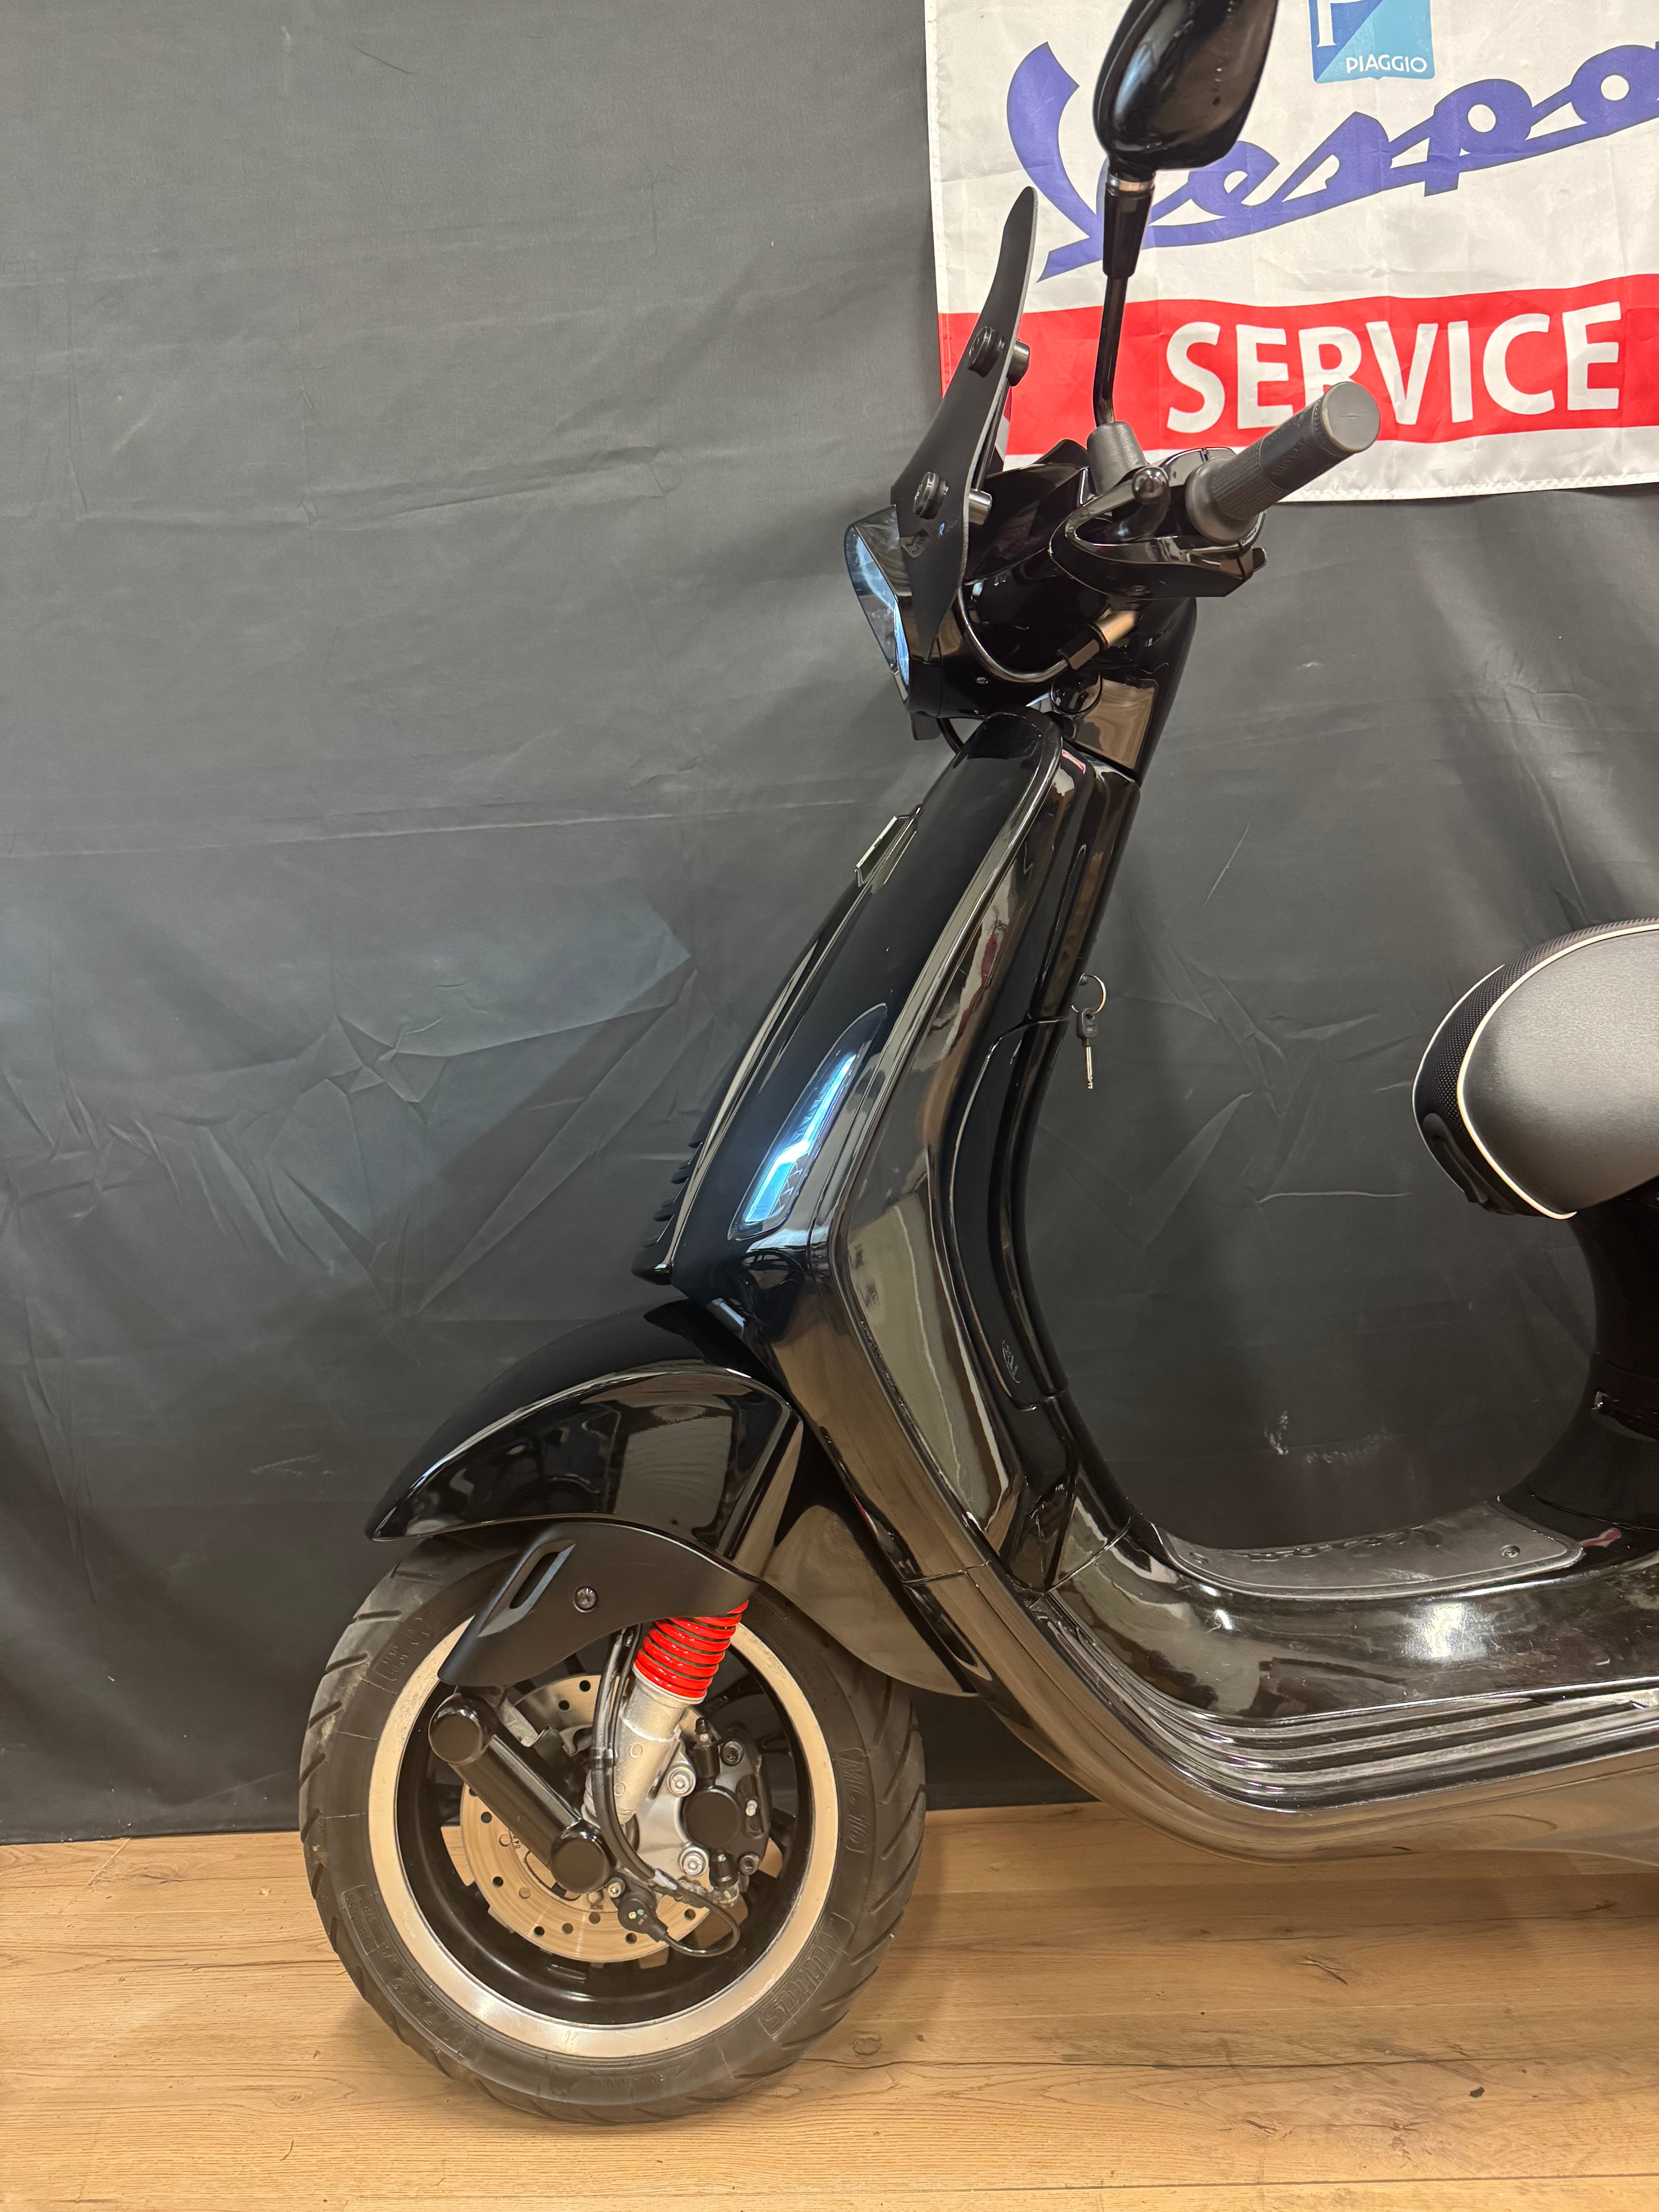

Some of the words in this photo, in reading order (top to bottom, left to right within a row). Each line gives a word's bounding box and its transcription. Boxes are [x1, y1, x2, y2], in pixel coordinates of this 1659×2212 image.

[1346, 53, 1427, 74] PIAGGIO
[1006, 41, 1659, 282] Vespa
[1166, 301, 1621, 433] SERVICE
[762, 1918, 842, 2029] Mitas
